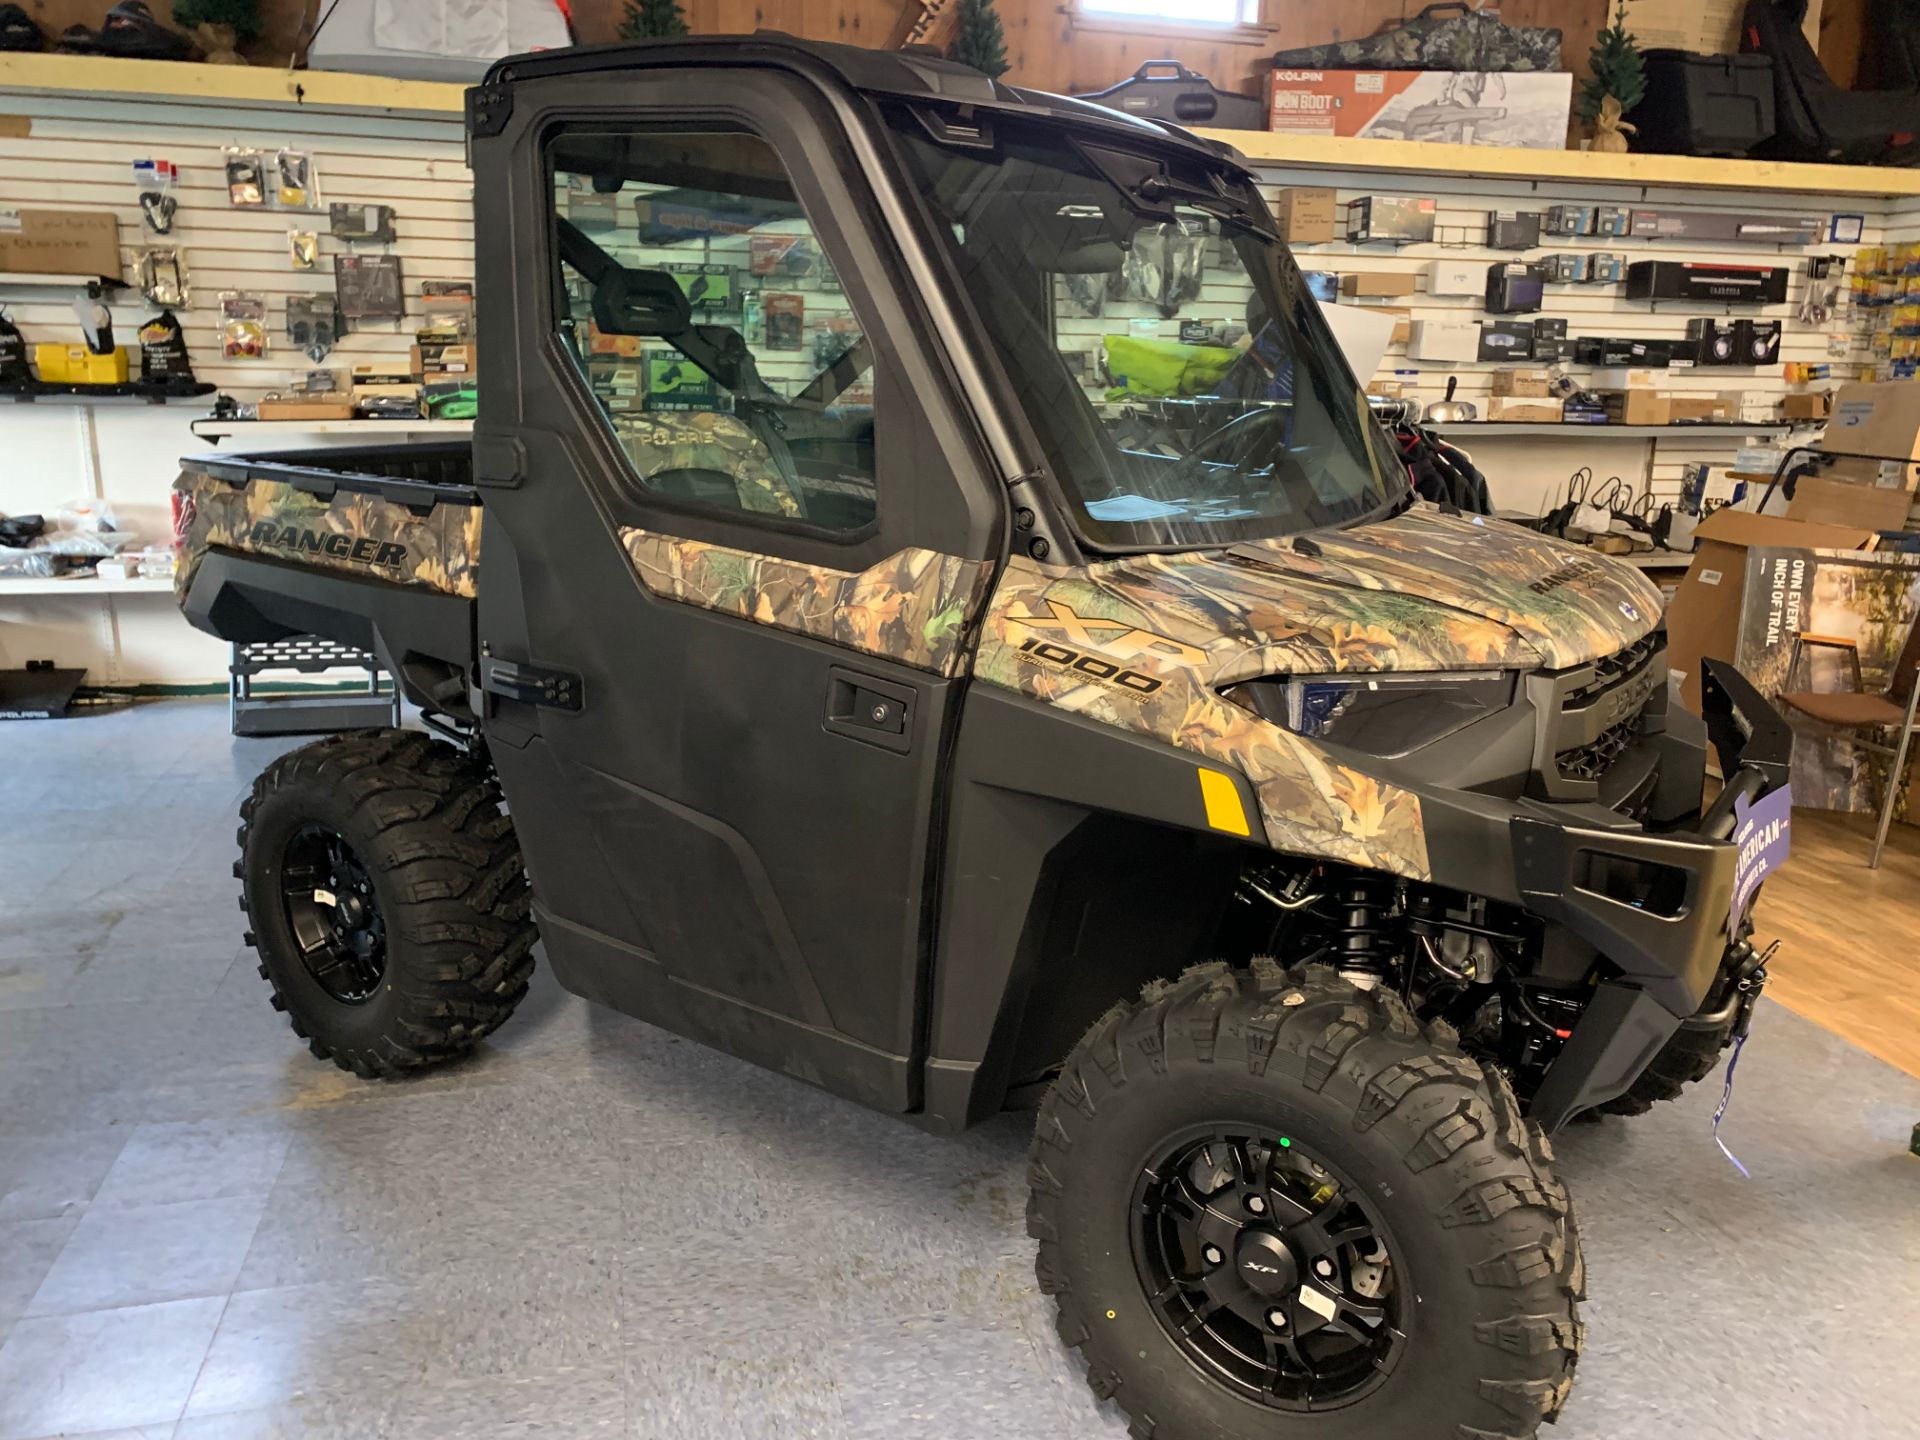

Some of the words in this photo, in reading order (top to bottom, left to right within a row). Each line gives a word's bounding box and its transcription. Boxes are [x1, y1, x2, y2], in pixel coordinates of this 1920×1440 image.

[1275, 71, 1324, 82] KOLPIN
[641, 426, 714, 447] POLARIS
[251, 520, 408, 569] RANGER
[1772, 558, 1789, 589] INCH
[1790, 559, 1806, 590] OWN
[1770, 591, 1785, 609] OF
[1784, 591, 1802, 632] EVERY
[1001, 598, 1210, 666] XP
[1765, 610, 1782, 648] TRAIL
[1018, 637, 1163, 694] 1000
[1739, 817, 1780, 880] AMERICAN
